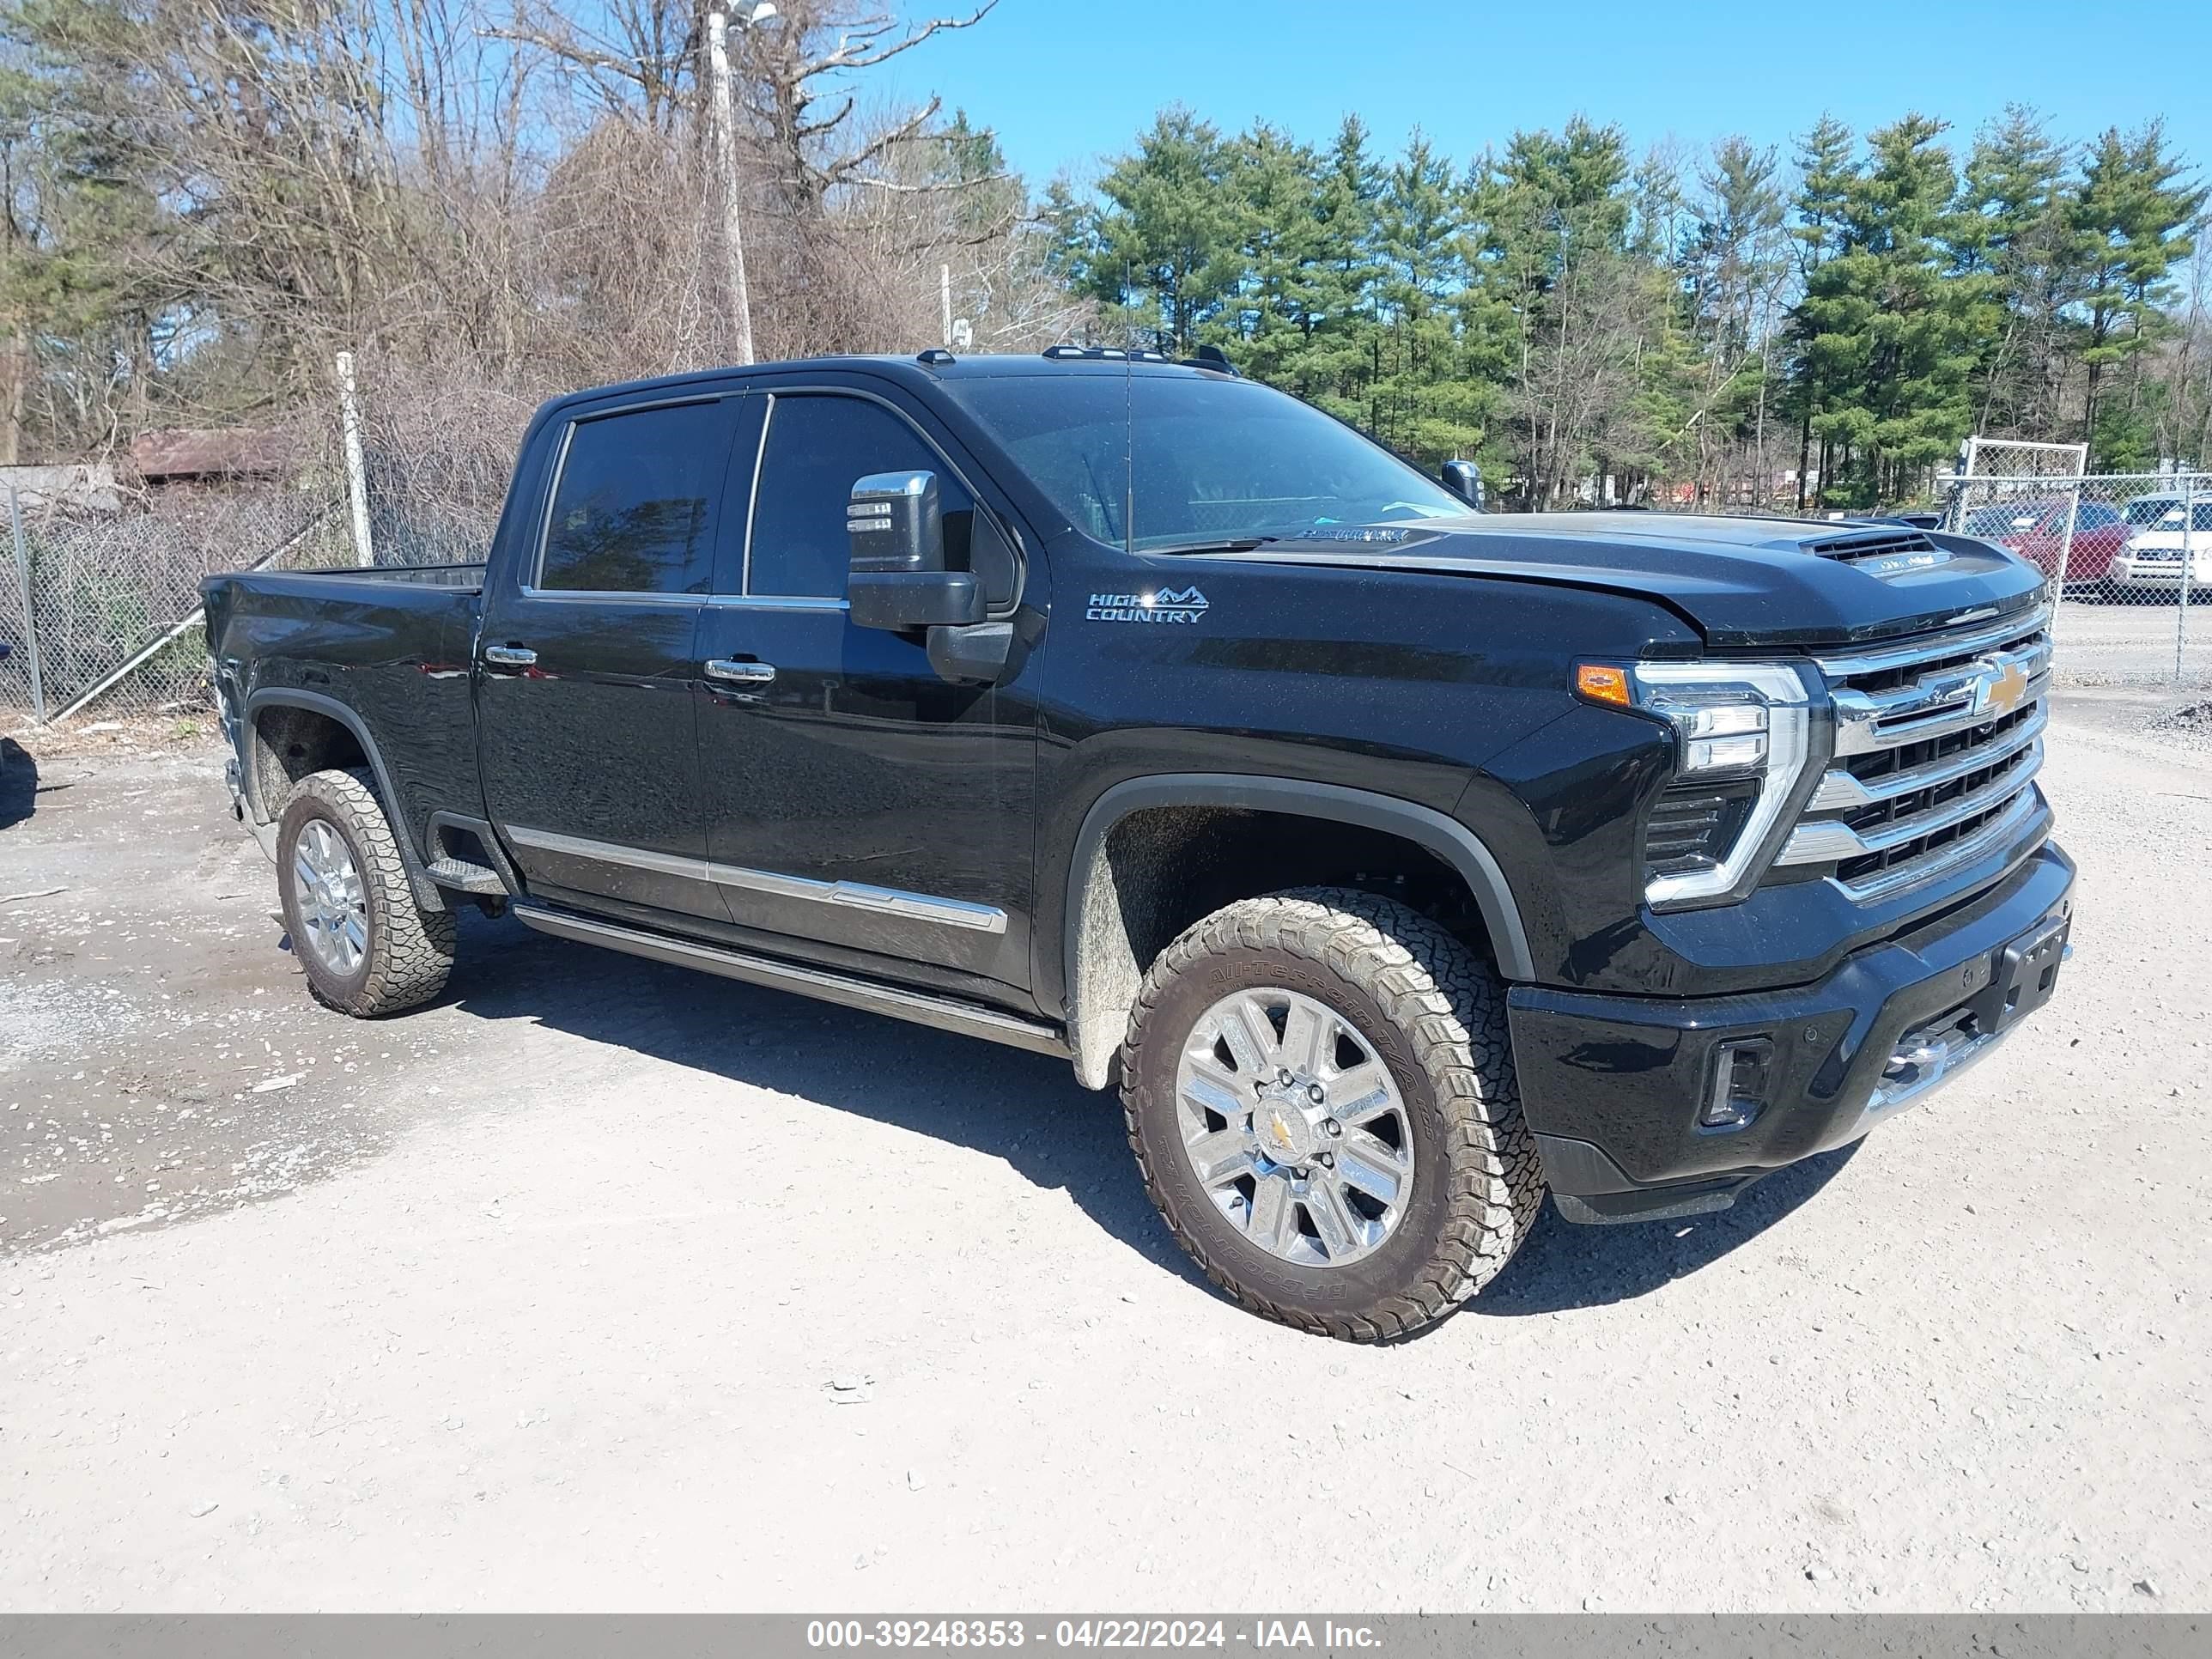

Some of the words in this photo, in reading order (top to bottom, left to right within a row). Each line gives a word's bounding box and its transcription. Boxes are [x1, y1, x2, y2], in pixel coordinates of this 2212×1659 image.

[1085, 608, 1206, 624] COUNTRY
[1089, 593, 1150, 606] HIGH
[1209, 960, 1374, 1027] All-Terrain
[1376, 1029, 1419, 1092] T/A
[1175, 1183, 1348, 1300] BFGoodrich
